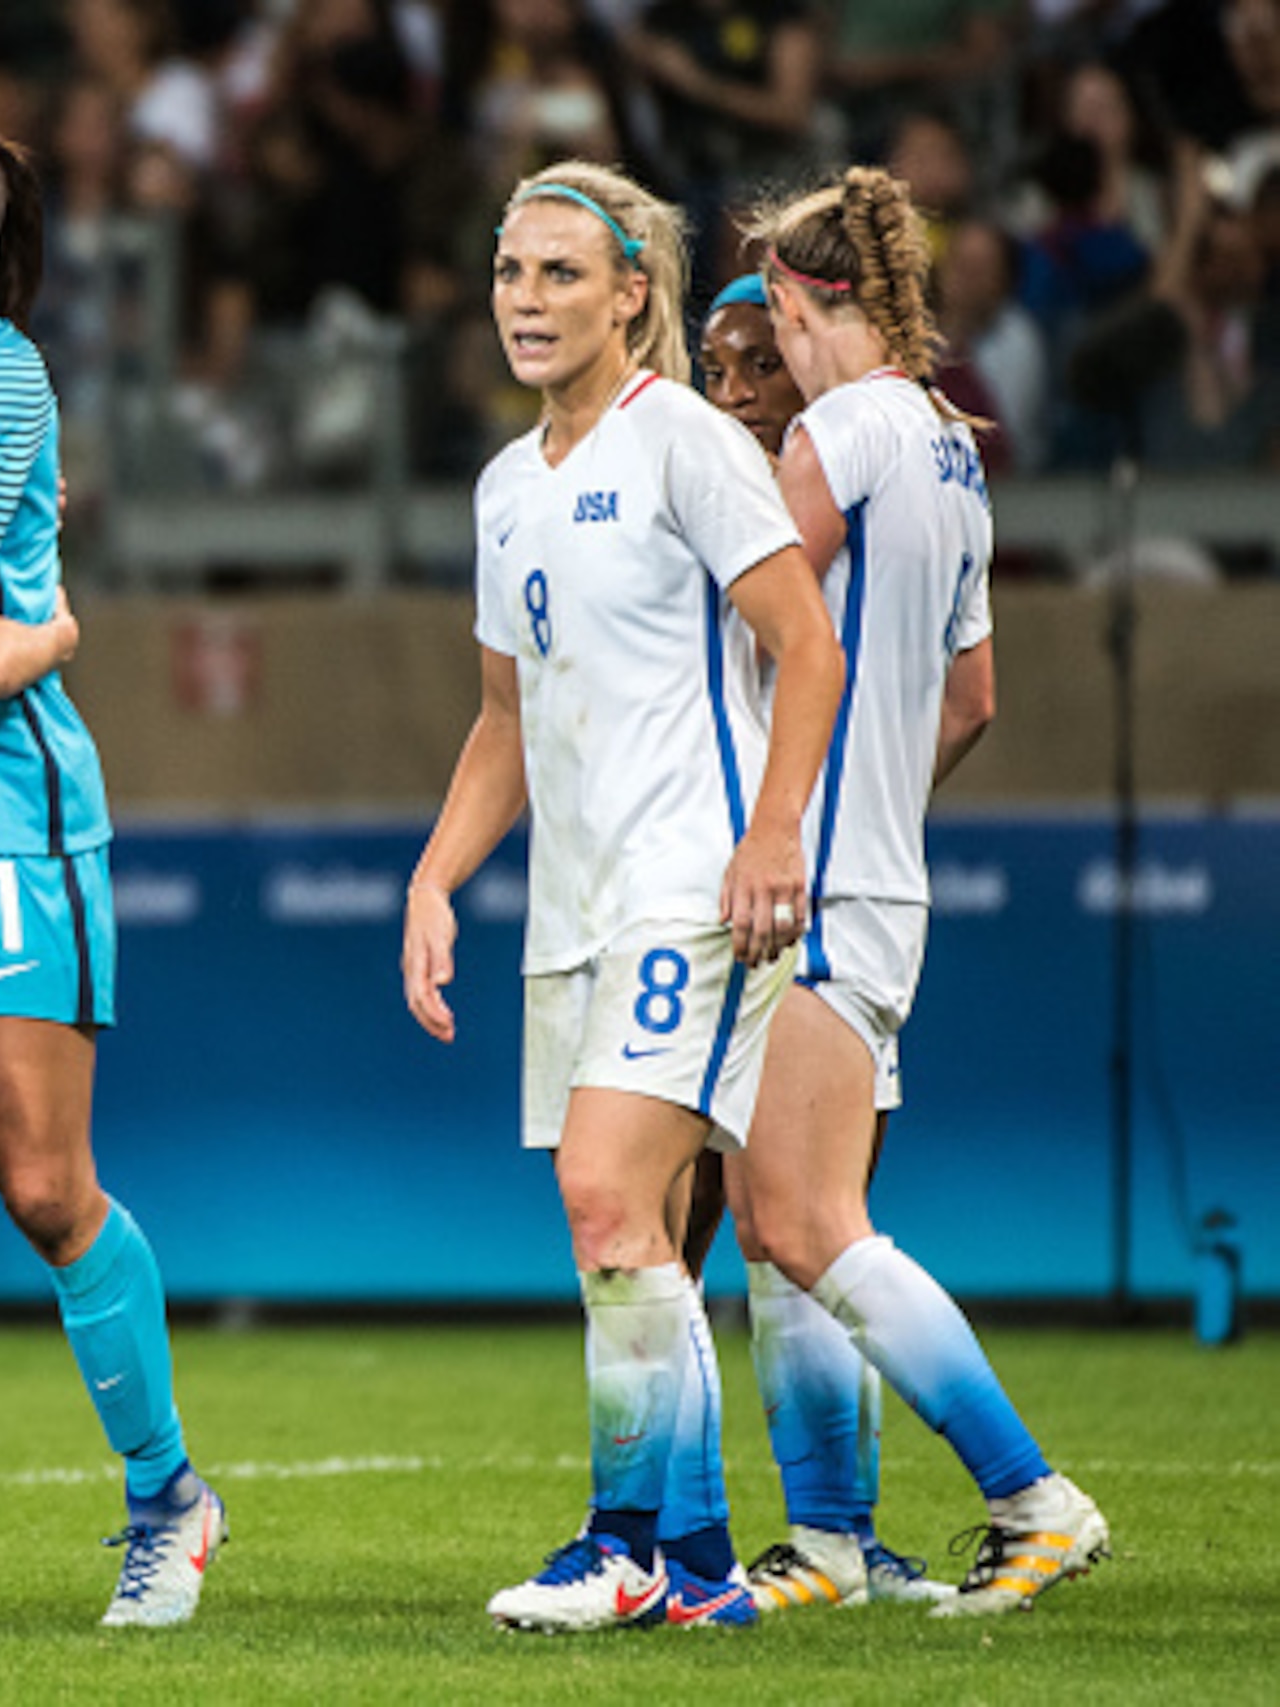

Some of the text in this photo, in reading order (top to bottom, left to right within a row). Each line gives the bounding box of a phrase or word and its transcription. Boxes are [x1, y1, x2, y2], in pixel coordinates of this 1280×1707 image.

[573, 490, 620, 523] USA
[524, 568, 552, 660] 8
[633, 947, 690, 1035] 8
